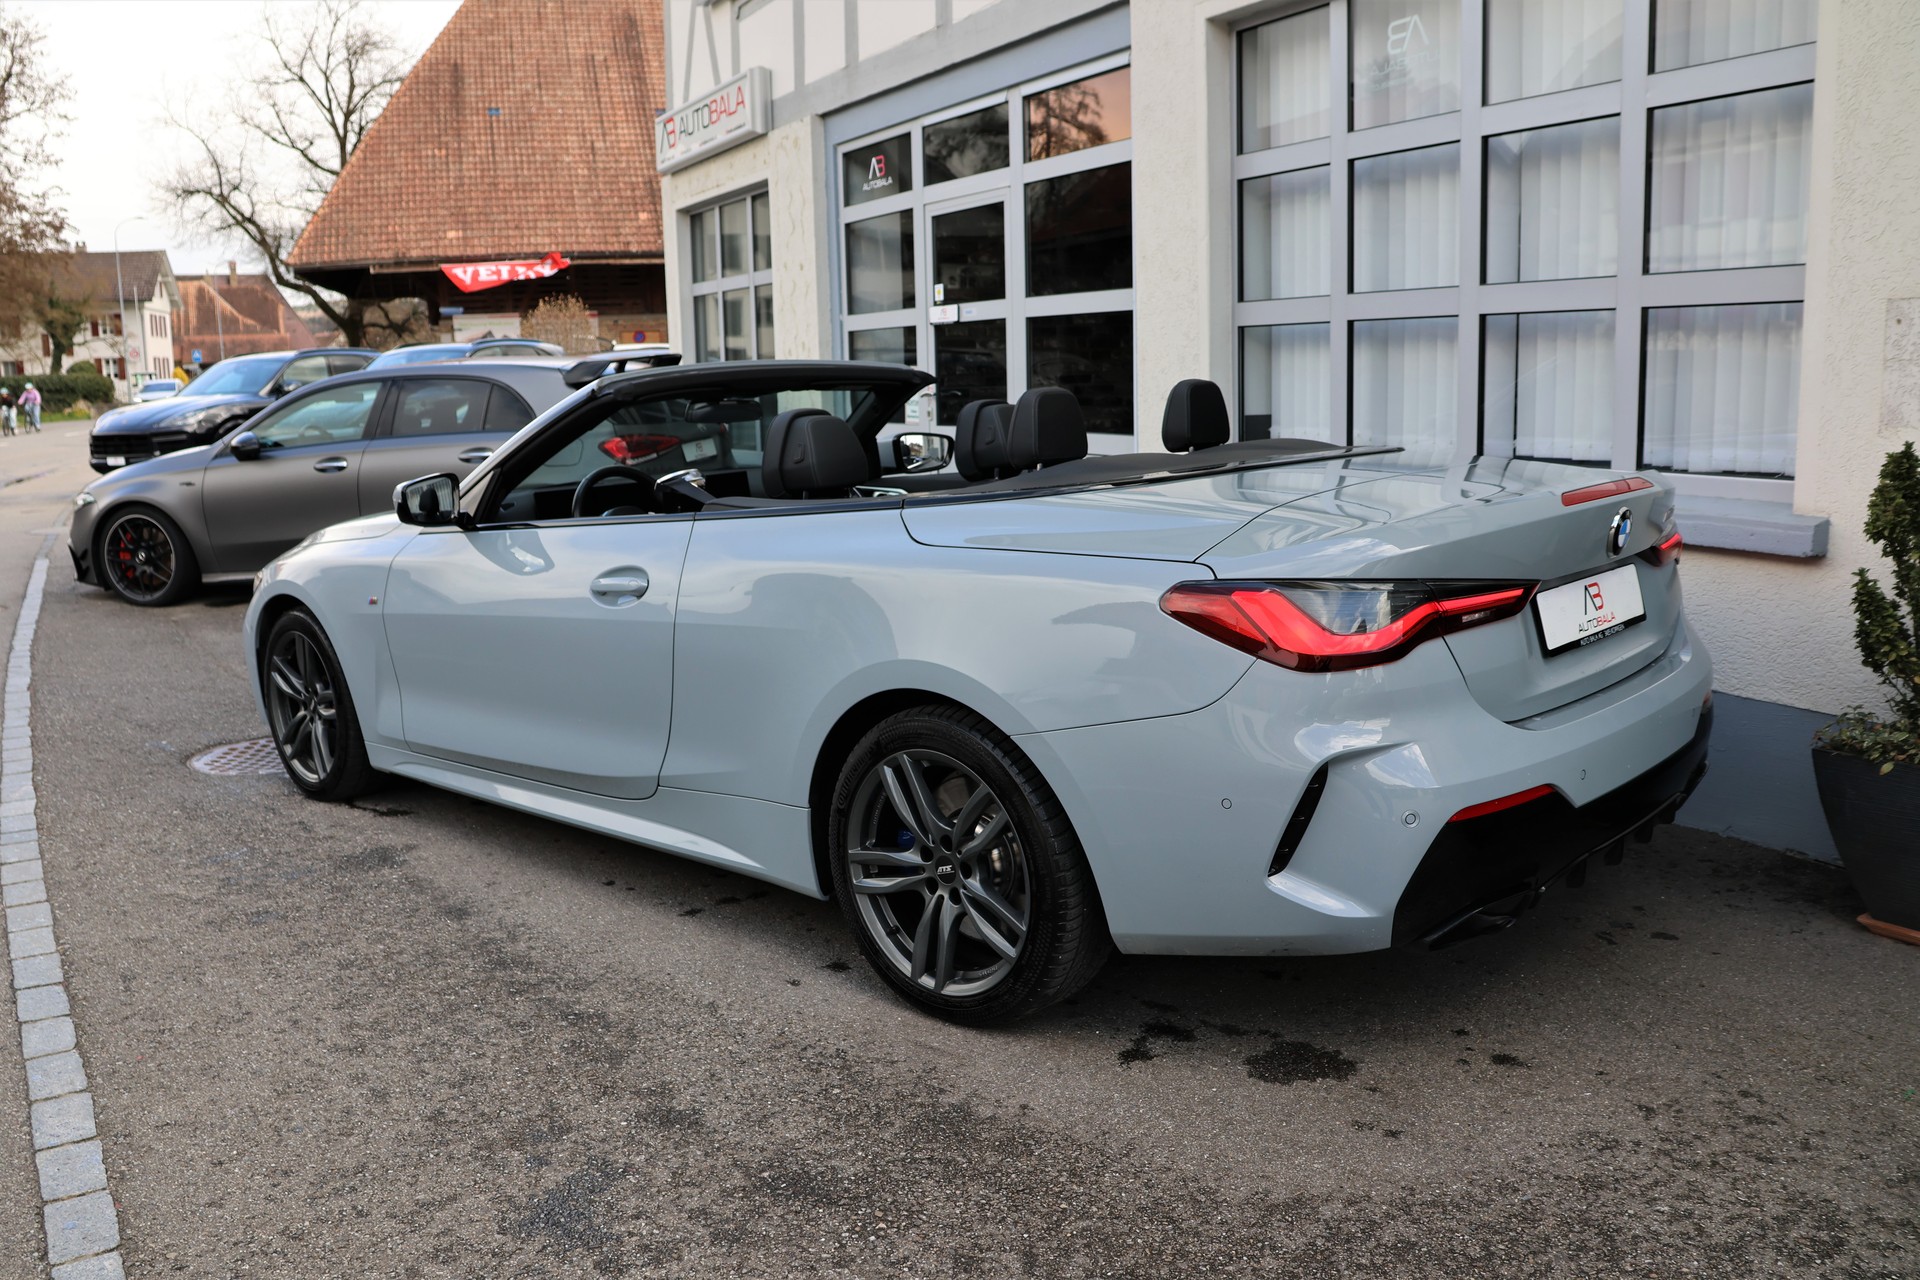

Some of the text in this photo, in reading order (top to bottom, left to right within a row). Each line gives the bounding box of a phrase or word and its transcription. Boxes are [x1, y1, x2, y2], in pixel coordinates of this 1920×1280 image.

[679, 85, 746, 139] AUTOBALA
[869, 154, 886, 179] AB
[1584, 581, 1605, 616] AB
[1578, 611, 1616, 634] AUTOBALA
